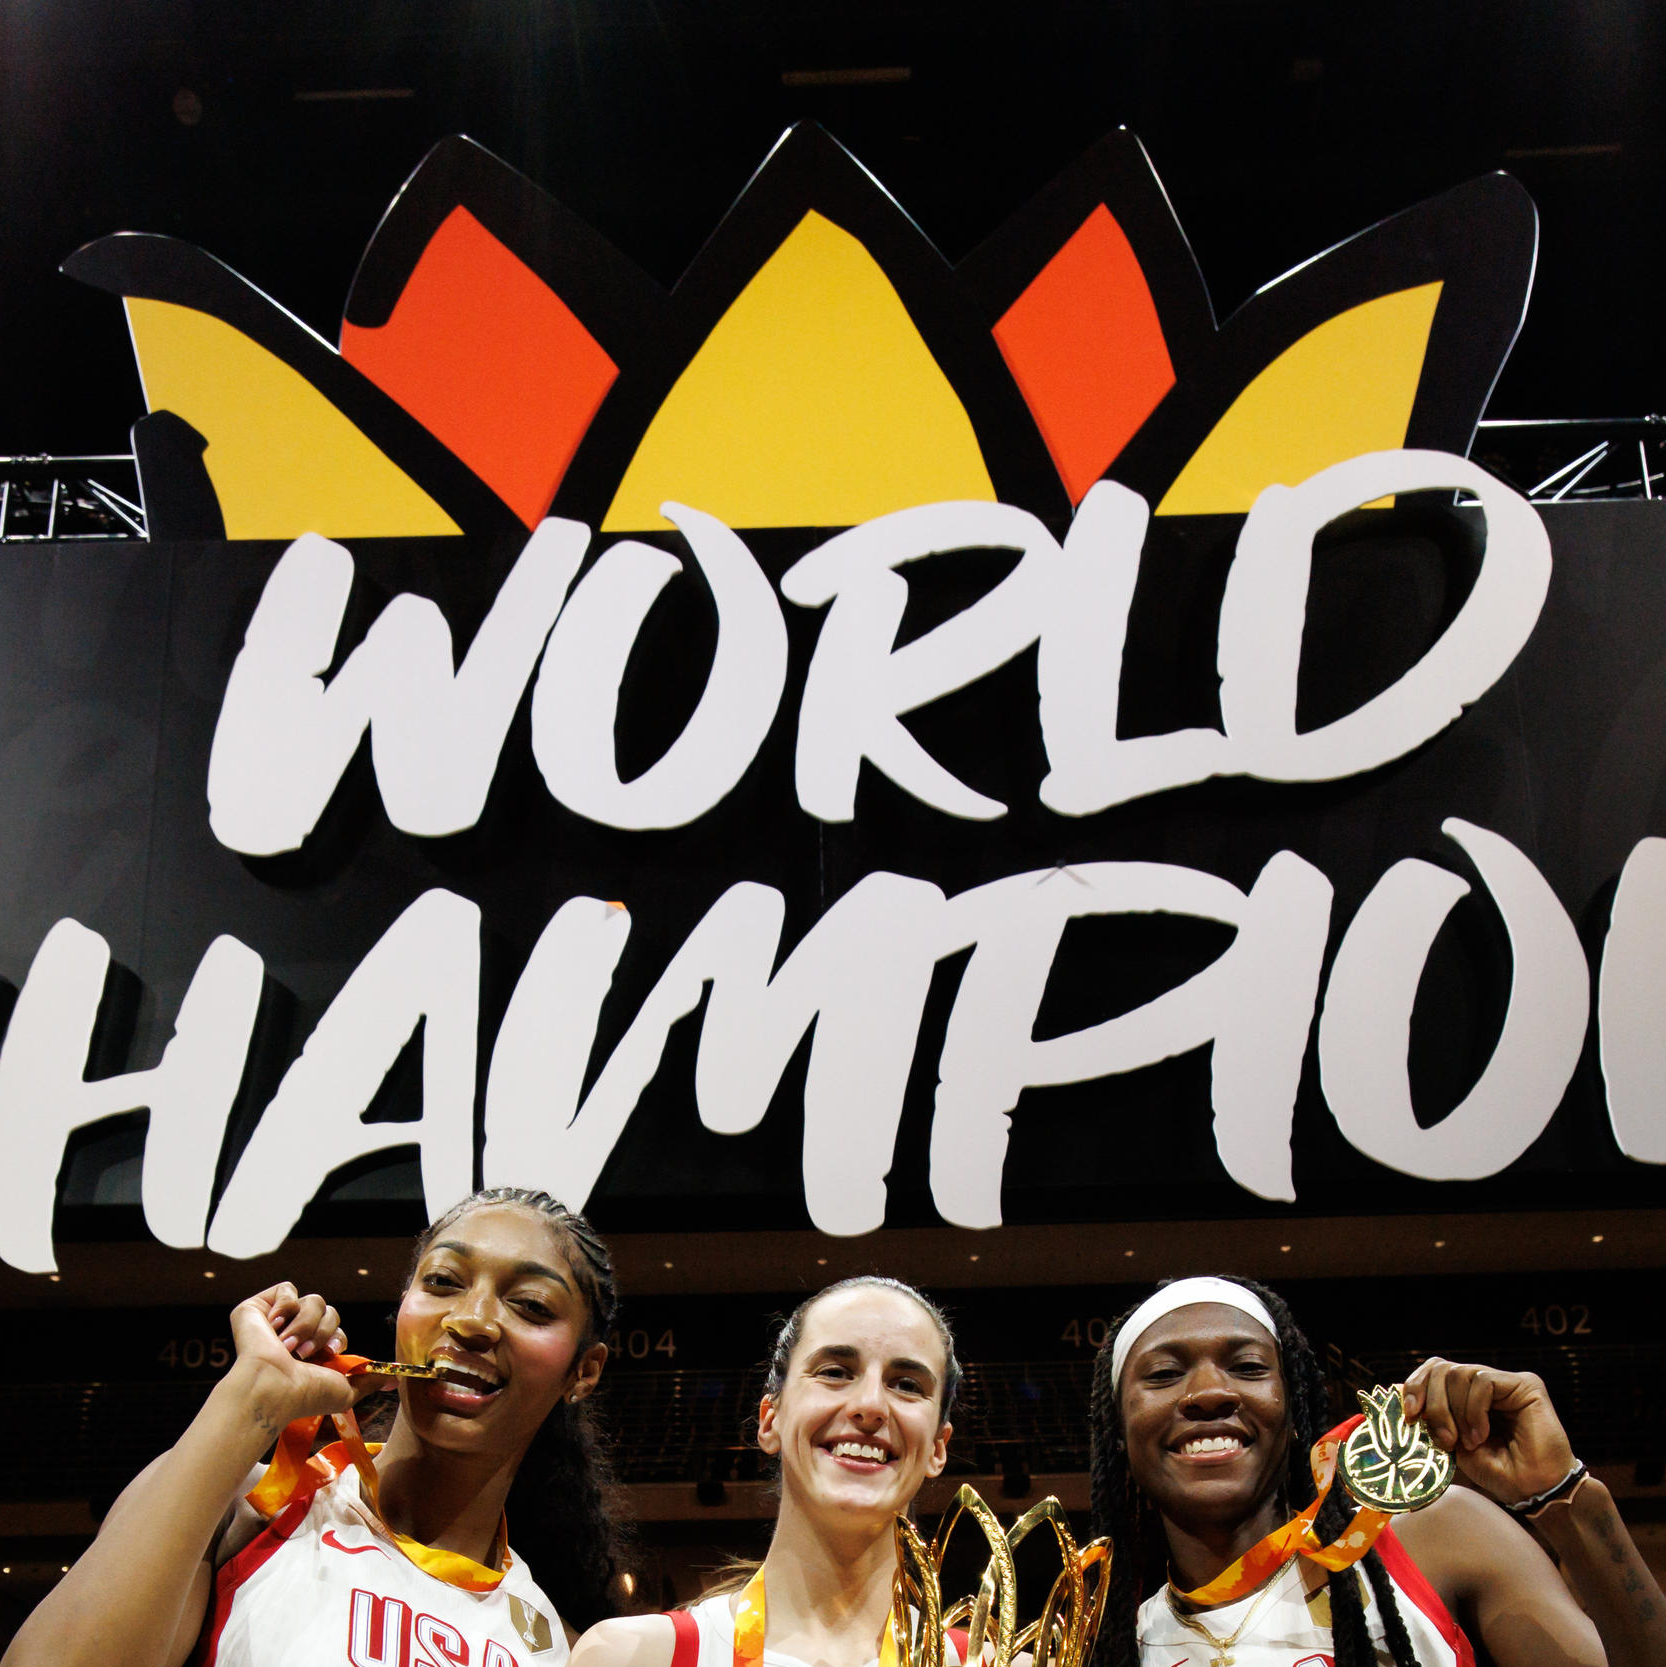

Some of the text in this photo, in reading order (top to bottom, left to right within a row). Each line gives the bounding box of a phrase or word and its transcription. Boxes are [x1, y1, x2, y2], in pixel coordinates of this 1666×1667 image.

[207, 447, 1552, 857] WORLD
[1061, 1317, 1110, 1349] 40
[1519, 1304, 1592, 1336] 402
[156, 1337, 230, 1368] 405
[608, 1328, 677, 1359] 404
